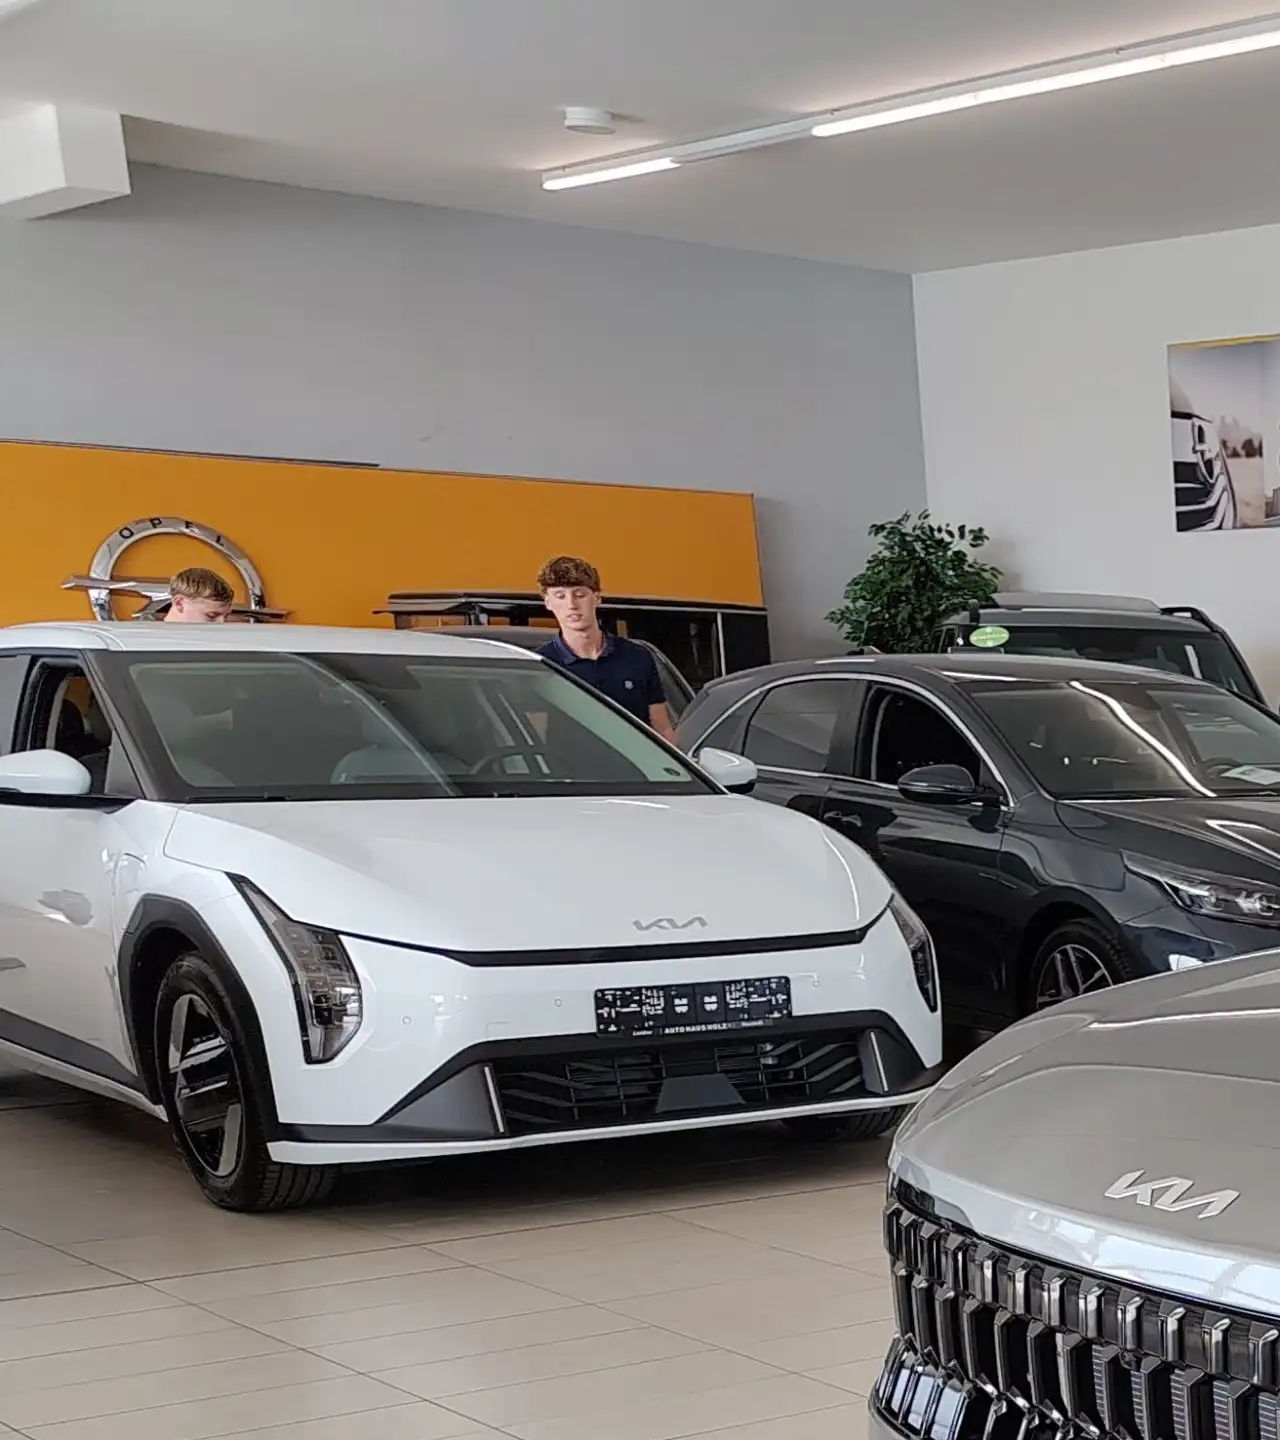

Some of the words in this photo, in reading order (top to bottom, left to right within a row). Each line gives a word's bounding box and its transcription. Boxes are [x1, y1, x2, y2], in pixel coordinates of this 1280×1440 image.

[118, 516, 226, 547] OPEL
[632, 915, 708, 932] KIA
[1103, 1168, 1241, 1220] KIA
